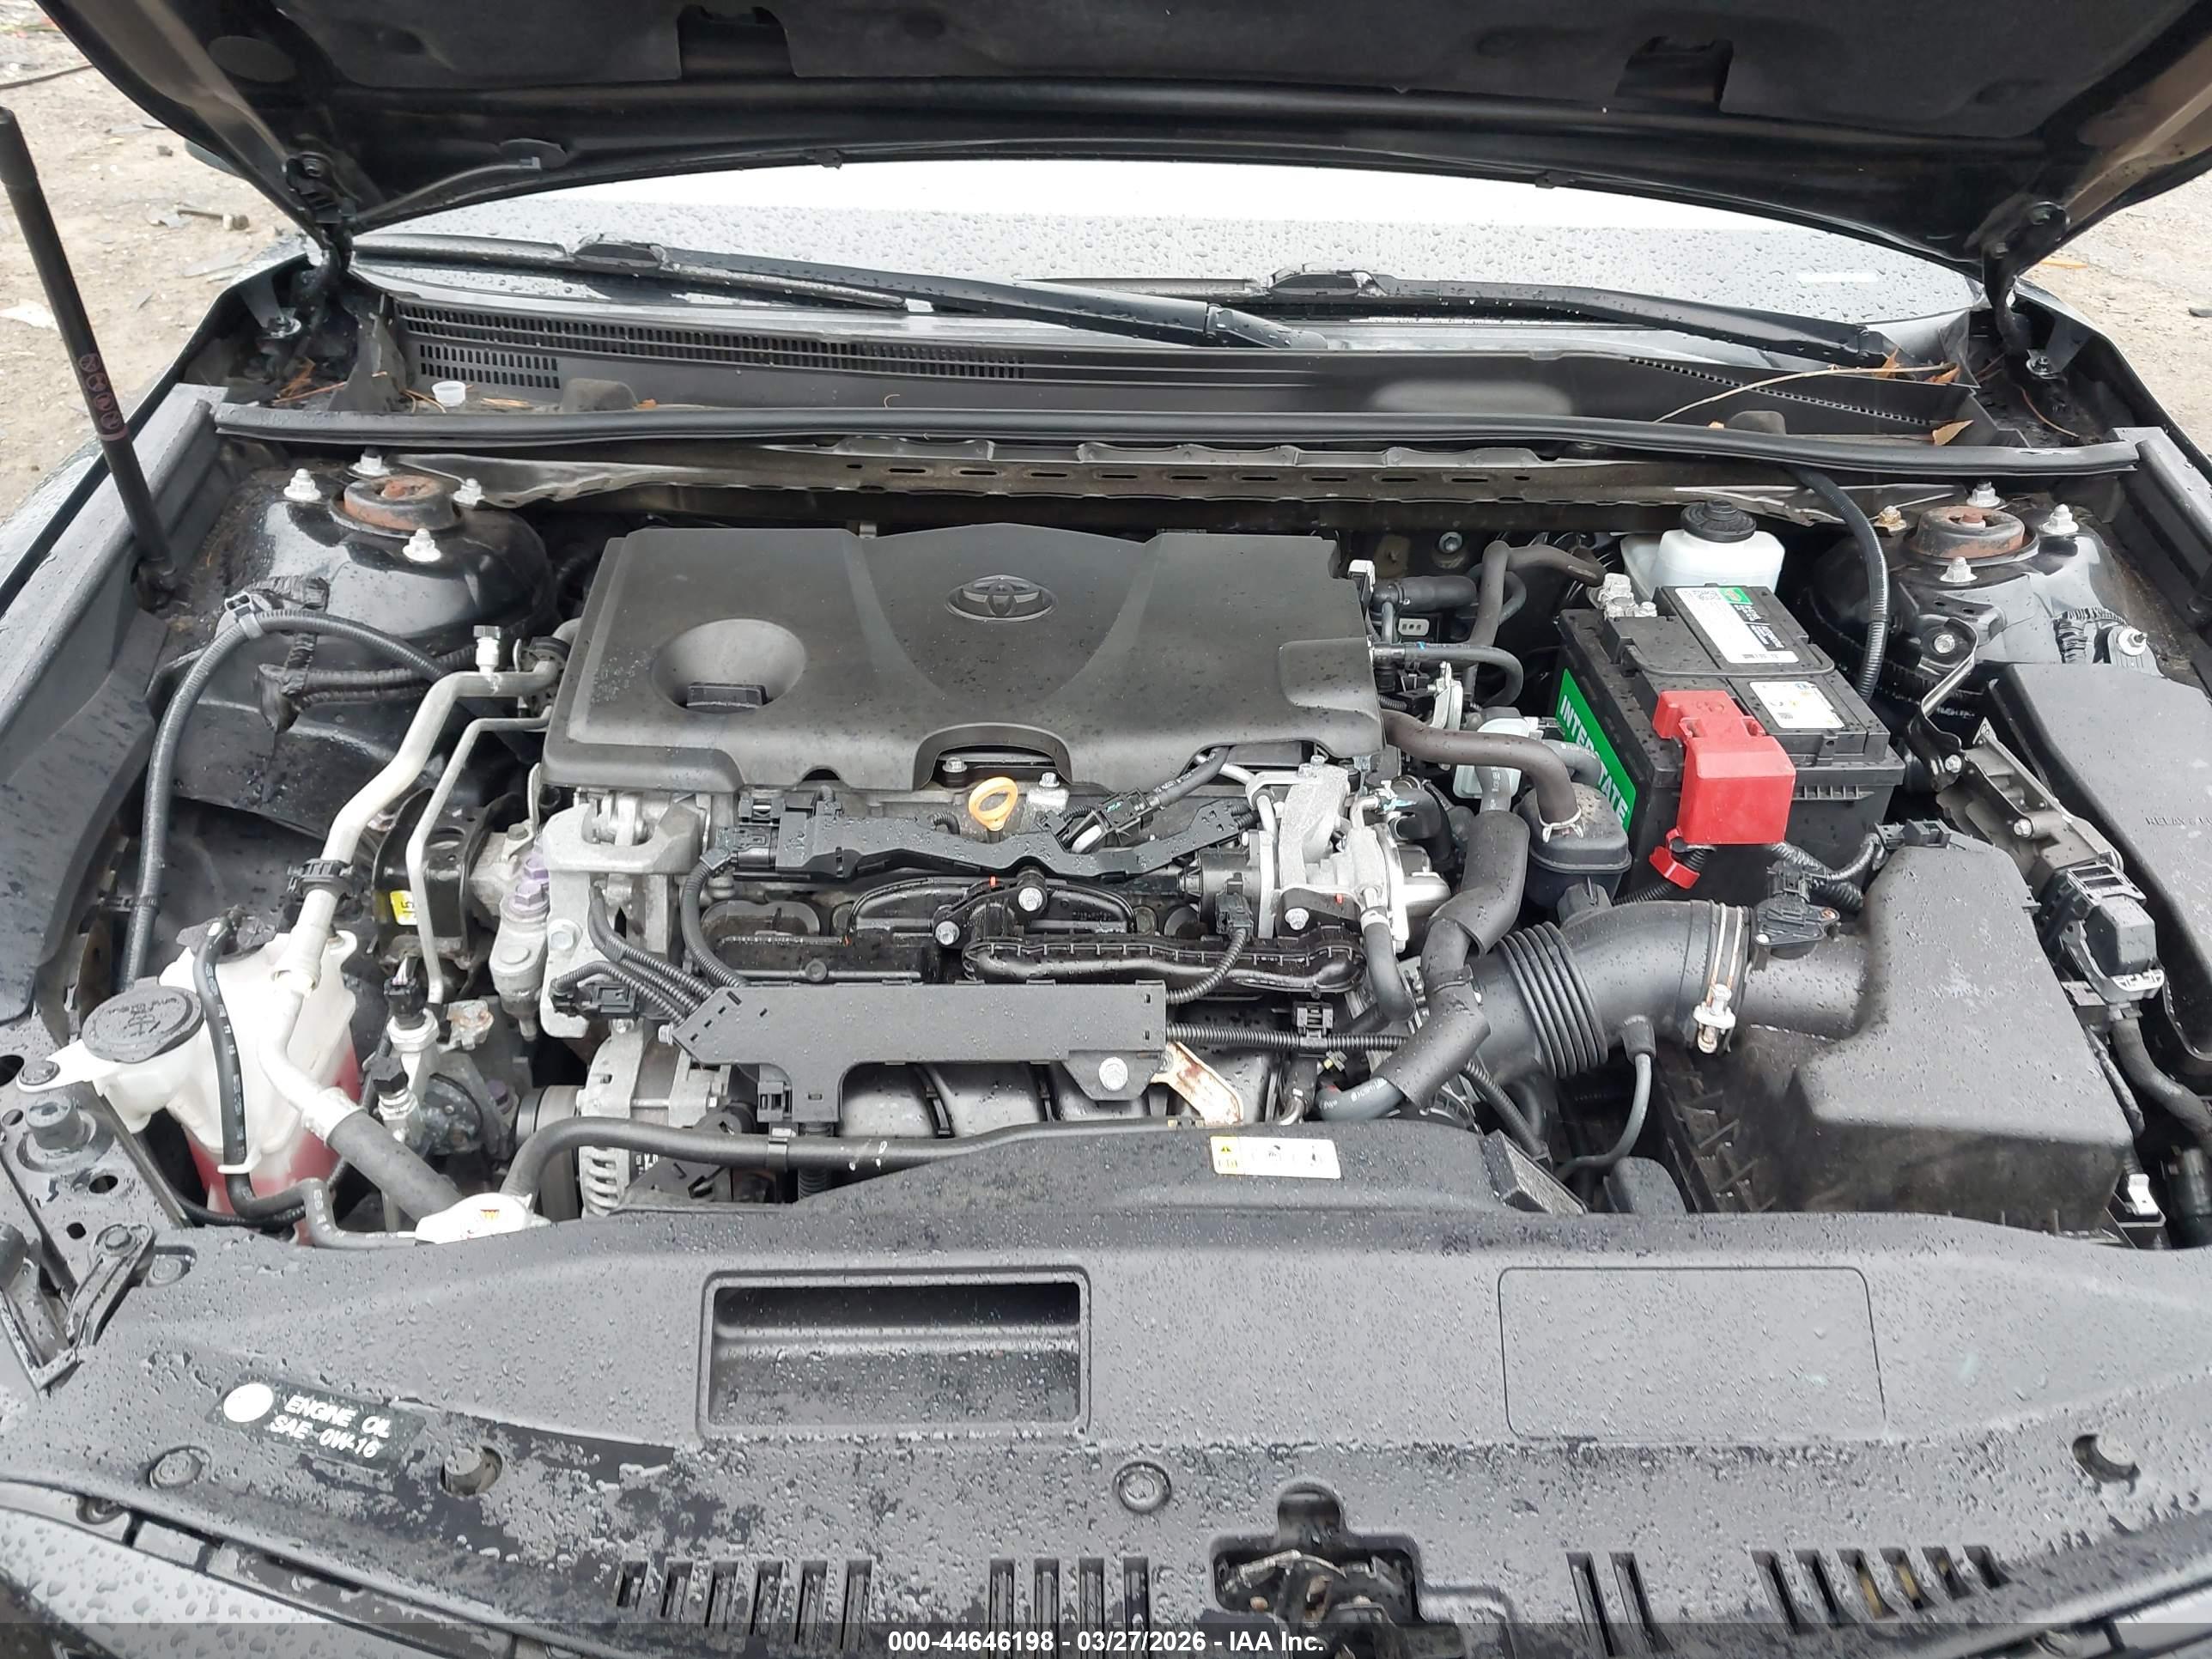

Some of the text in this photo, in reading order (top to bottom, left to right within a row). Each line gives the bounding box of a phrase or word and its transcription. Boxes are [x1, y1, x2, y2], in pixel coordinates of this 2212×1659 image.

[270, 1414, 380, 1459] SAE 0W-16
[283, 1394, 391, 1439] ENGINE OIL
